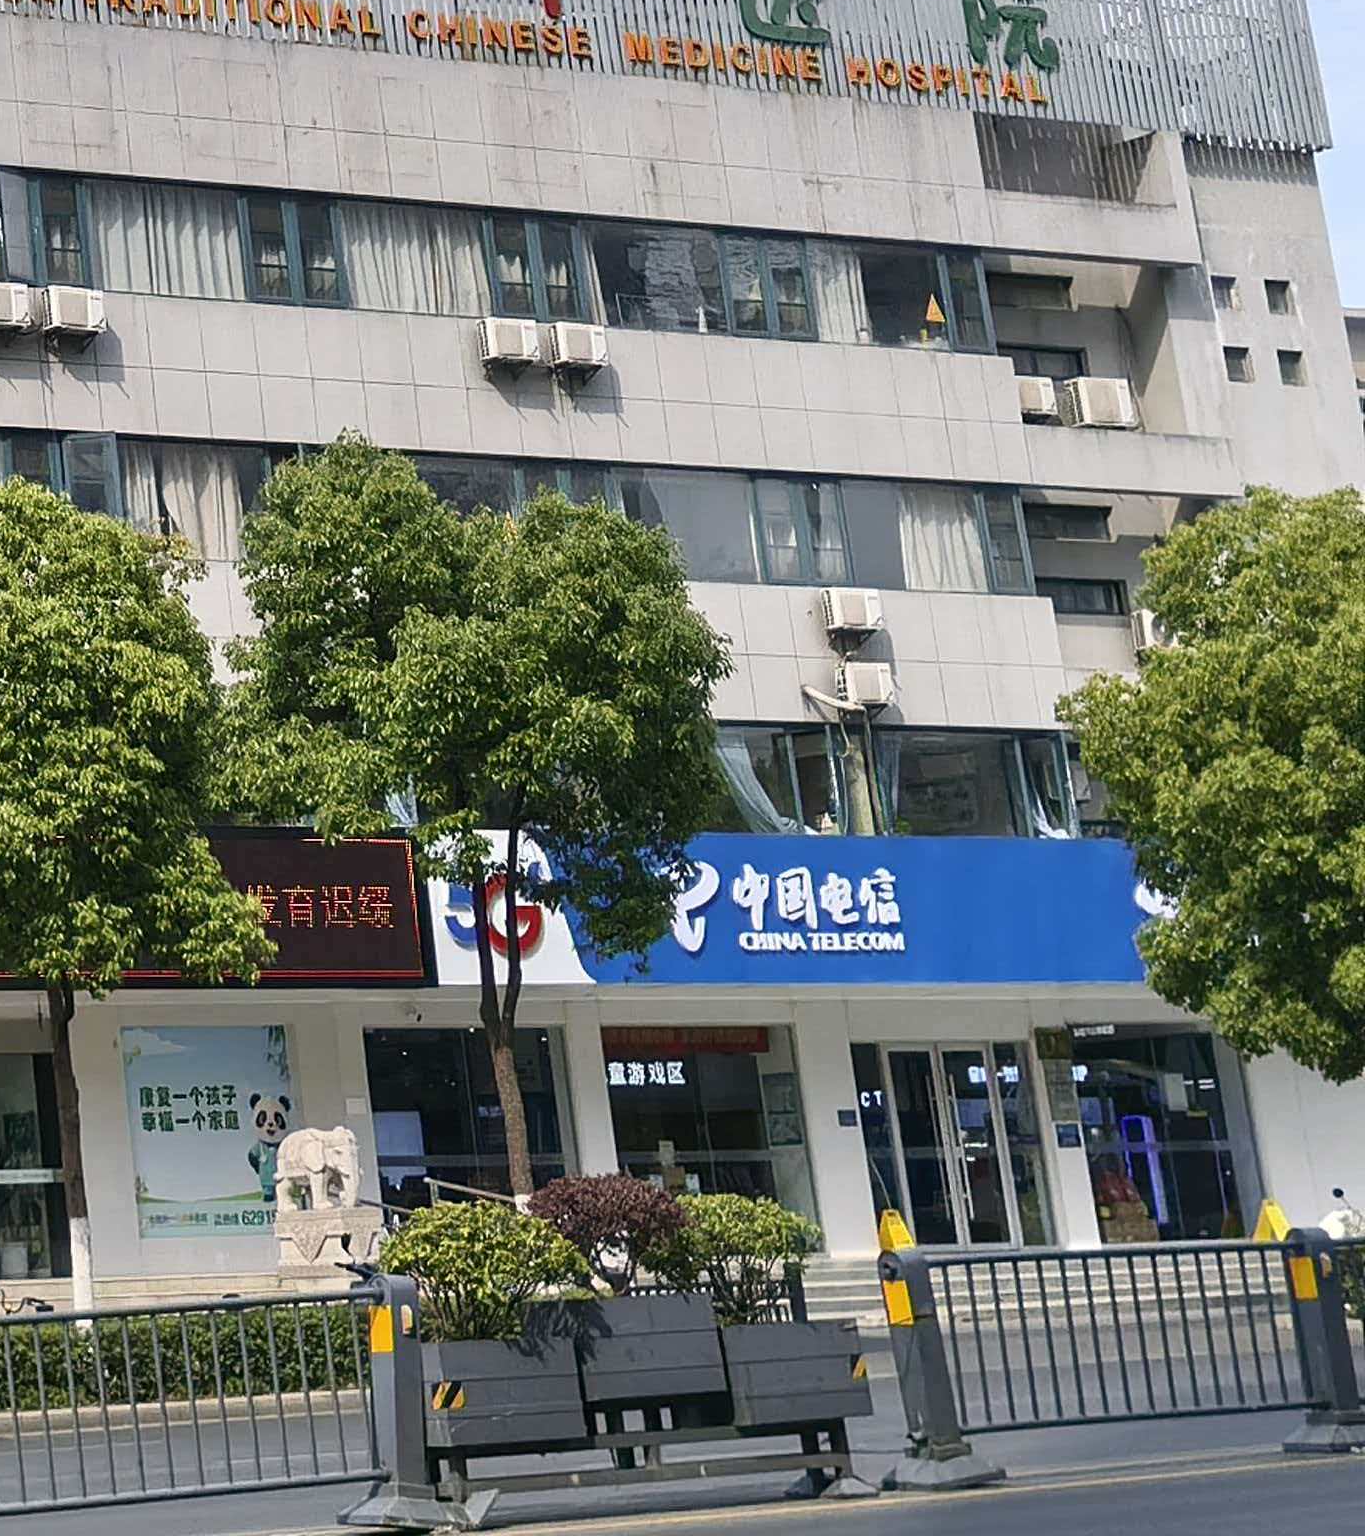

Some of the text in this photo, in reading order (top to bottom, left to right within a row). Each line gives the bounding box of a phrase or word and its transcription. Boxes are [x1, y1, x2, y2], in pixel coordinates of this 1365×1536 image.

[409, 10, 592, 59] CHINESE
[623, 31, 822, 81] MEDICINE
[846, 55, 1048, 104] HOSPITAL
[733, 864, 901, 930] 中国电信
[738, 931, 906, 951] CHINA TELECOM
[139, 1085, 236, 1107] 康复一个孩子
[141, 1110, 240, 1131] 幸福一个家庭
